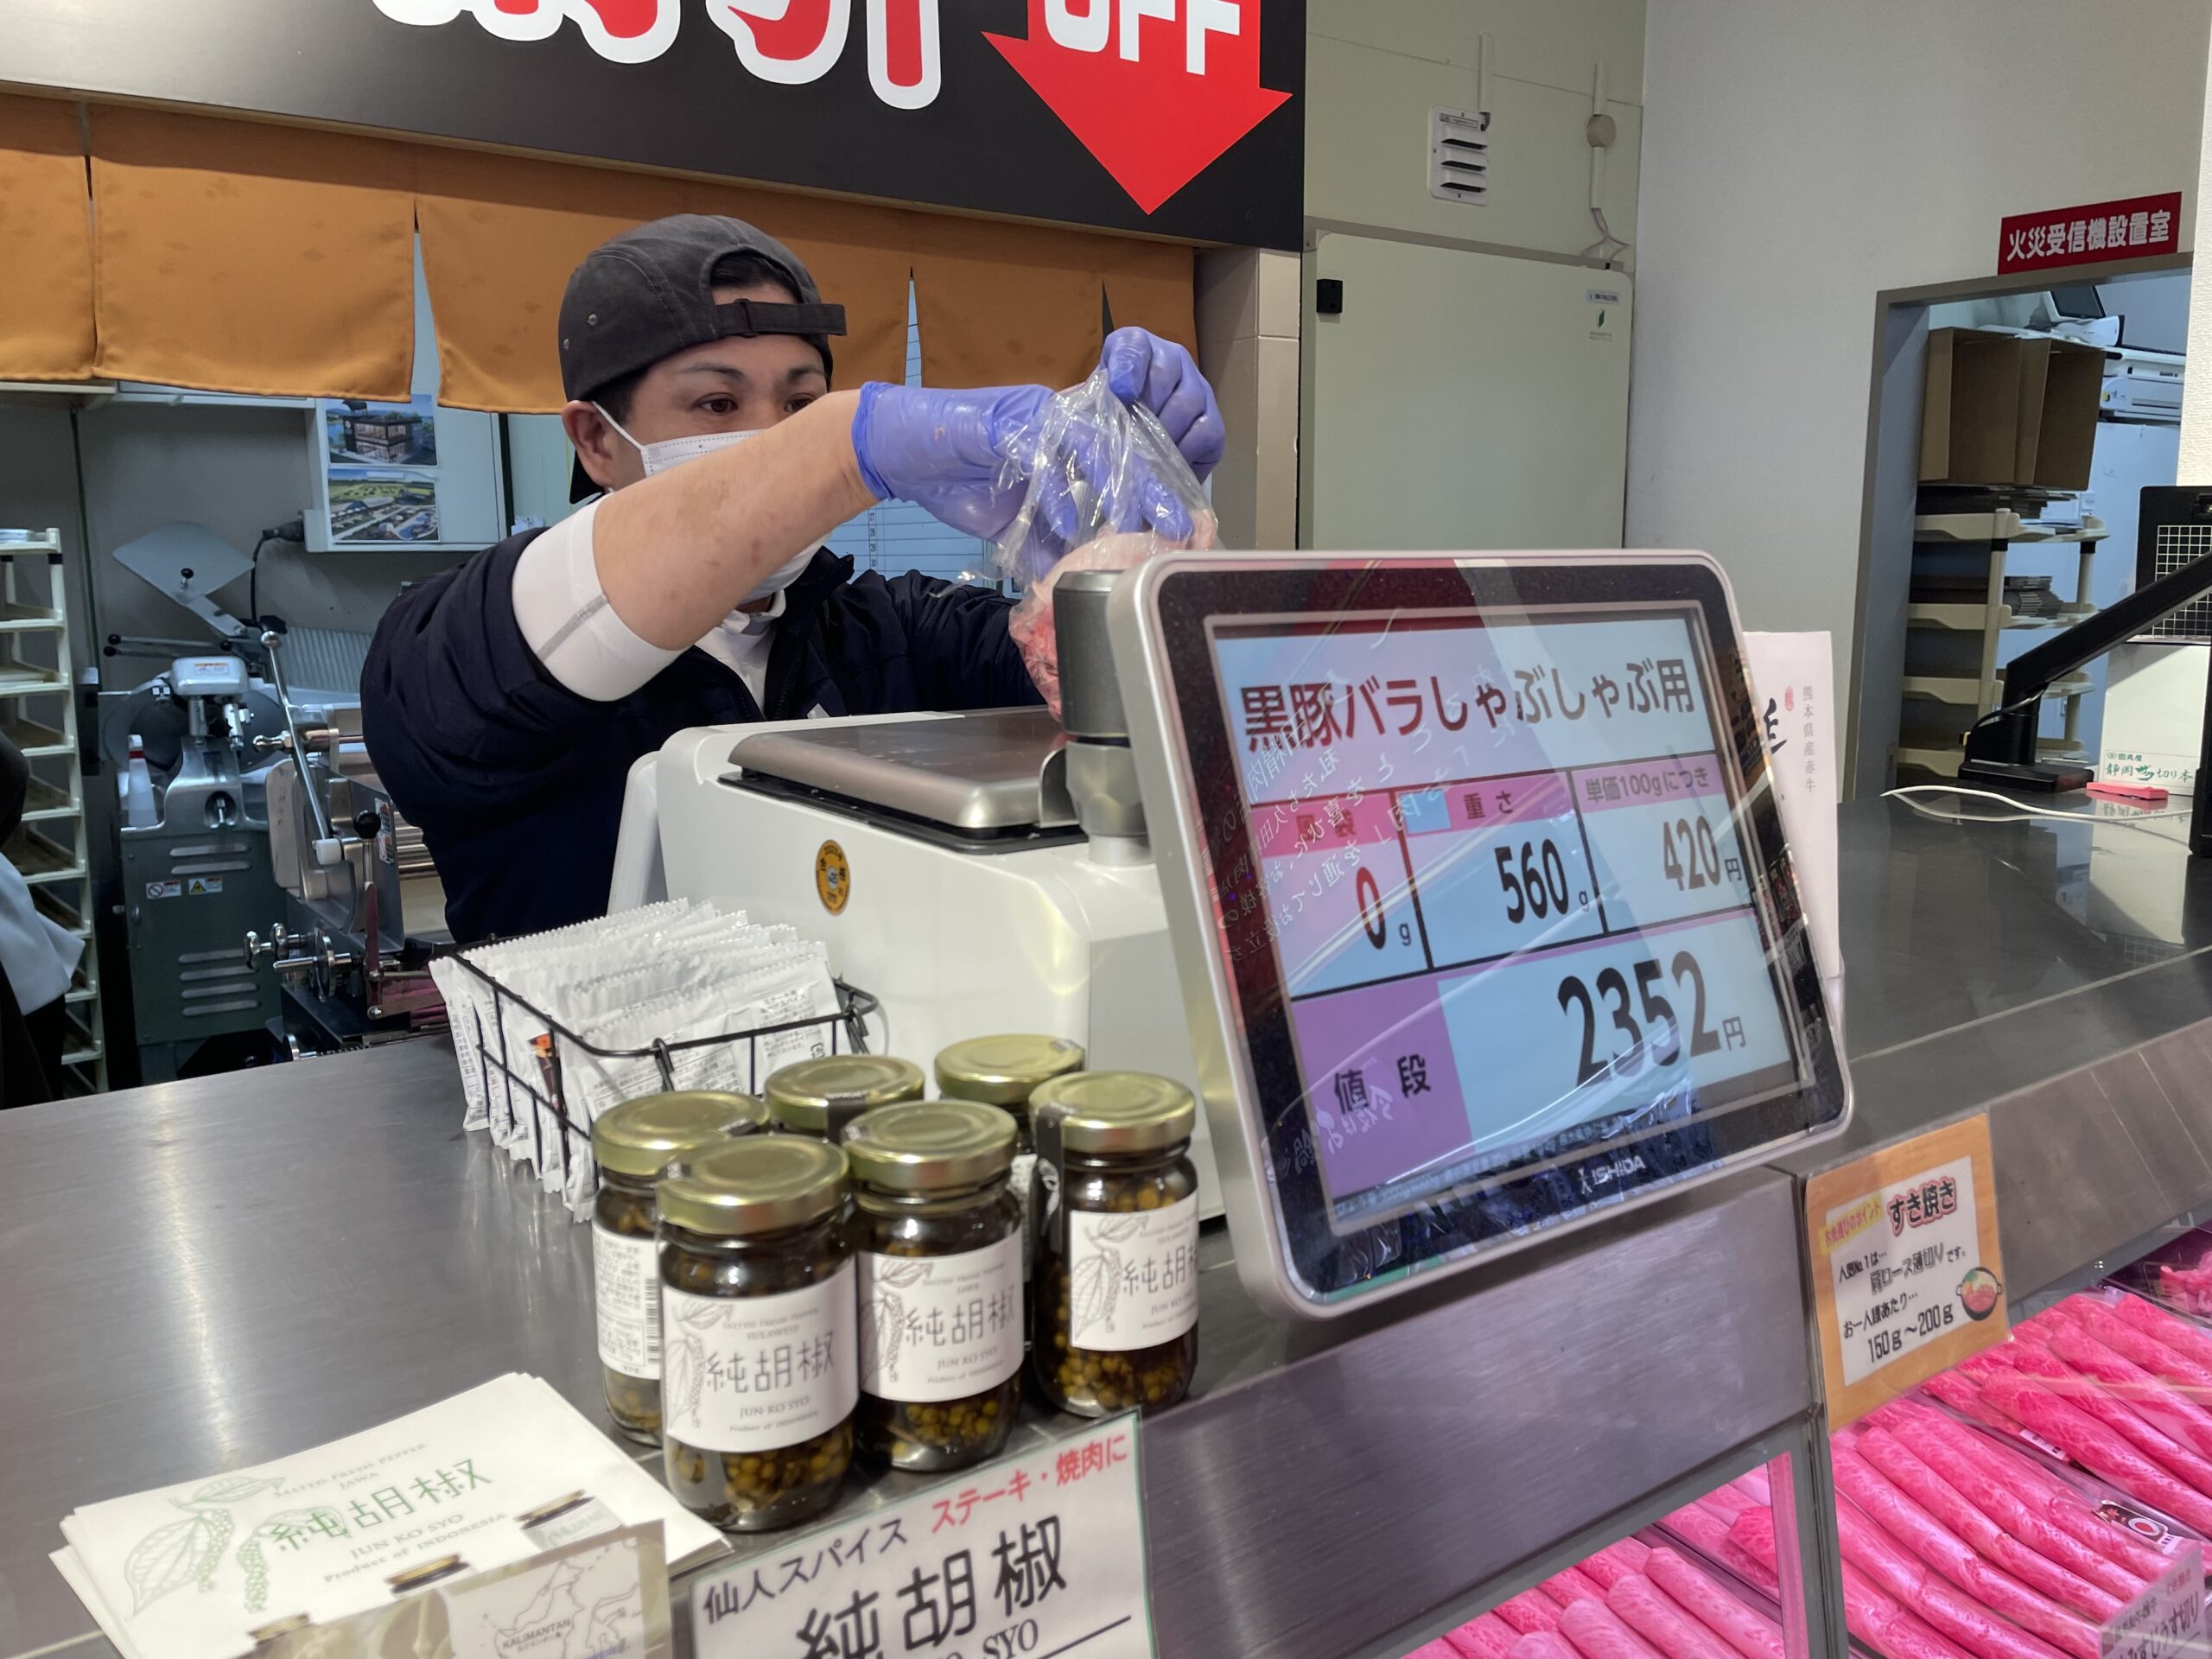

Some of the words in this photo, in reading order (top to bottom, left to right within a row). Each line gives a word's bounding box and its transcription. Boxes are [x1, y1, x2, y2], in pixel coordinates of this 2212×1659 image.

[2006, 209, 2171, 262] 火災受信機設置室
[1241, 658, 1696, 753] 黒豚バラしゃぶしゃぶ用
[1802, 685, 1816, 793] 熊本県産赤牛
[1464, 790, 1514, 820] 重さ
[1585, 766, 1709, 804] 単価100gにつき
[1494, 838, 1569, 924] 560
[1579, 890, 1591, 912] g
[1662, 815, 1721, 891] 420
[1725, 857, 1743, 883] 円
[1356, 866, 1386, 950] 0
[1399, 923, 1411, 945] g
[1558, 950, 1722, 1089] 2352
[1722, 1016, 1746, 1052] 円
[1334, 1053, 1432, 1115] 値段
[1591, 1154, 1647, 1185] ISHIDA
[1889, 1179, 1956, 1233] すき焼き
[906, 1283, 1015, 1347] 純胡椒
[706, 1330, 835, 1394] 純胡椒
[740, 1406, 764, 1420] JUN
[767, 1402, 785, 1415] KO
[787, 1396, 810, 1411] SYO
[272, 1477, 328, 1499] SALTED
[331, 1462, 377, 1482] FRESH
[378, 1442, 429, 1465] PEPPER
[340, 1471, 381, 1491] JAWA
[931, 1433, 1128, 1535] ステーキ・焼肉に
[269, 1458, 493, 1552] 純胡椒
[350, 1539, 391, 1560] JUN
[395, 1528, 424, 1545] KO
[427, 1513, 467, 1533] SYO
[702, 1518, 909, 1626] 仙人スパイス
[795, 1515, 1068, 1659] 純胡椒
[502, 1618, 571, 1650] KALIMANTAN
[982, 1618, 1040, 1659] SYO
